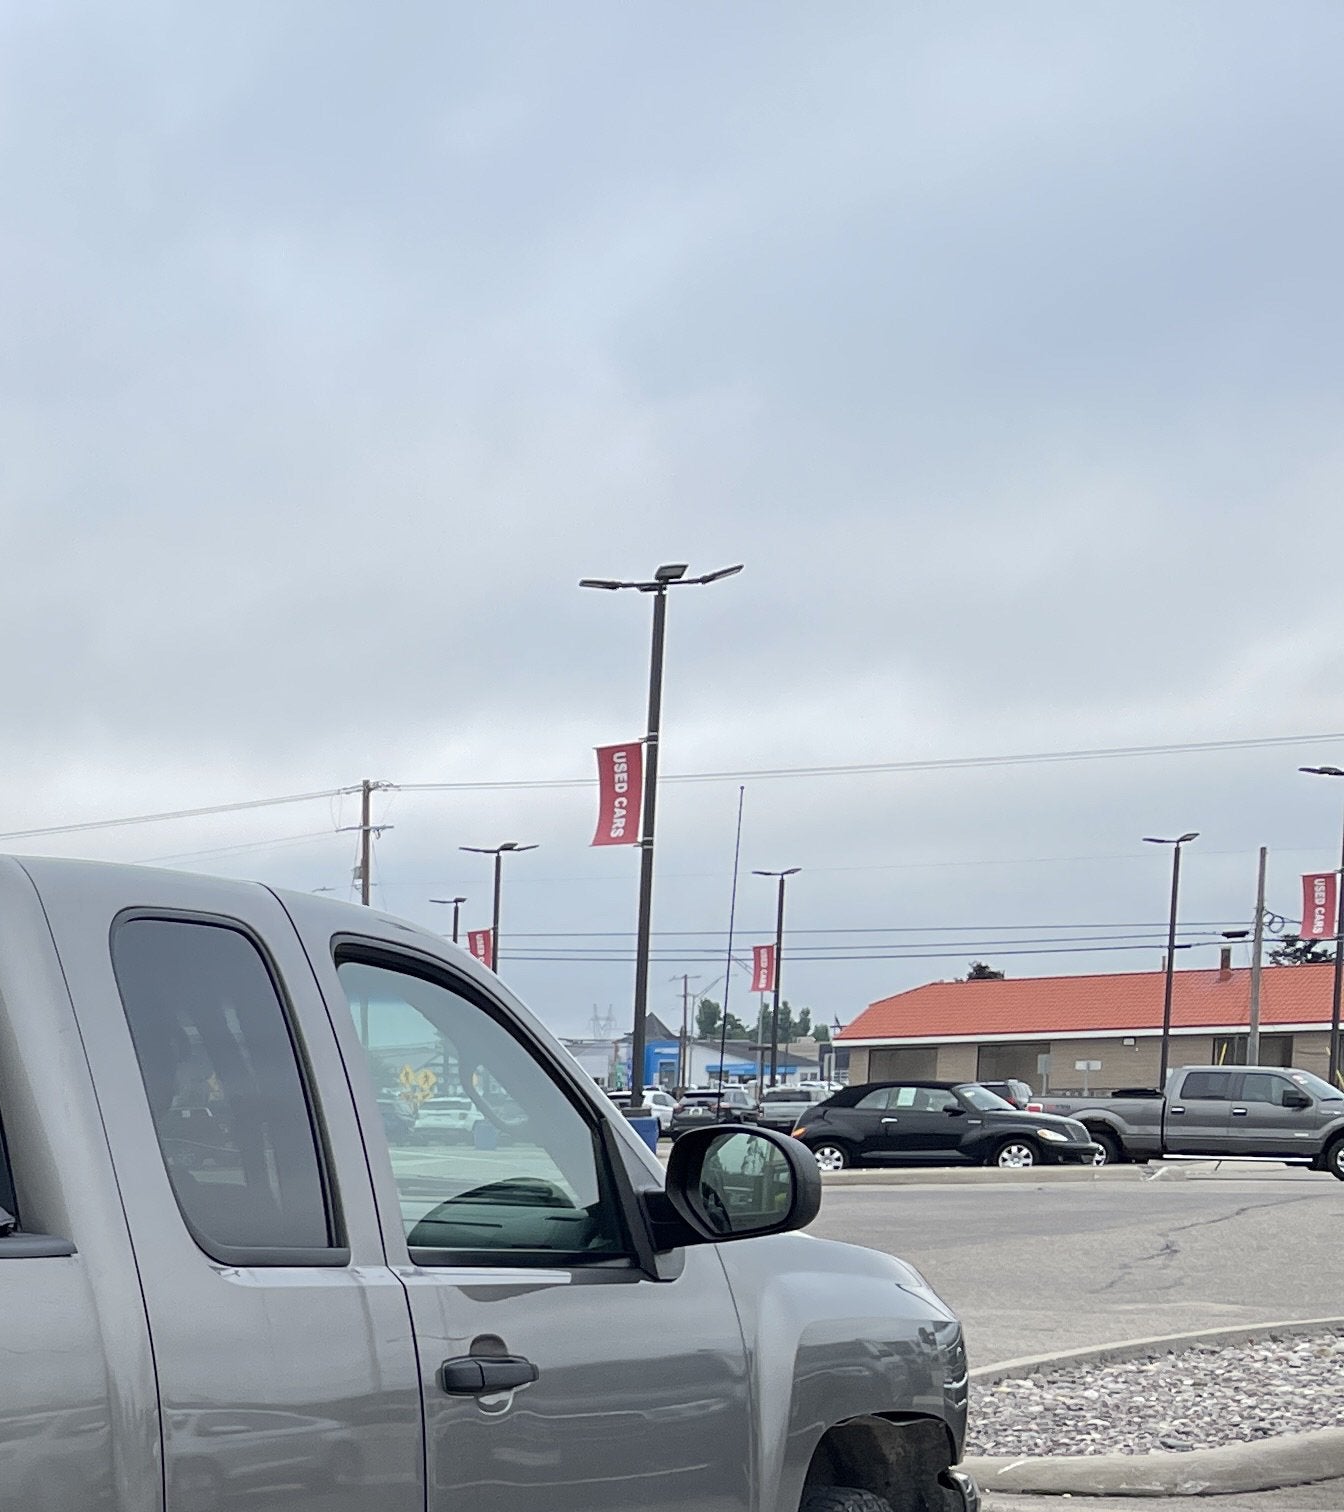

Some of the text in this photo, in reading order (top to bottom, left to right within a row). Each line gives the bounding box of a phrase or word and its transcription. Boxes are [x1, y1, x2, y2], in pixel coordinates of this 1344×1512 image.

[610, 751, 628, 838] USED CARS
[1312, 878, 1326, 934] USED CARS
